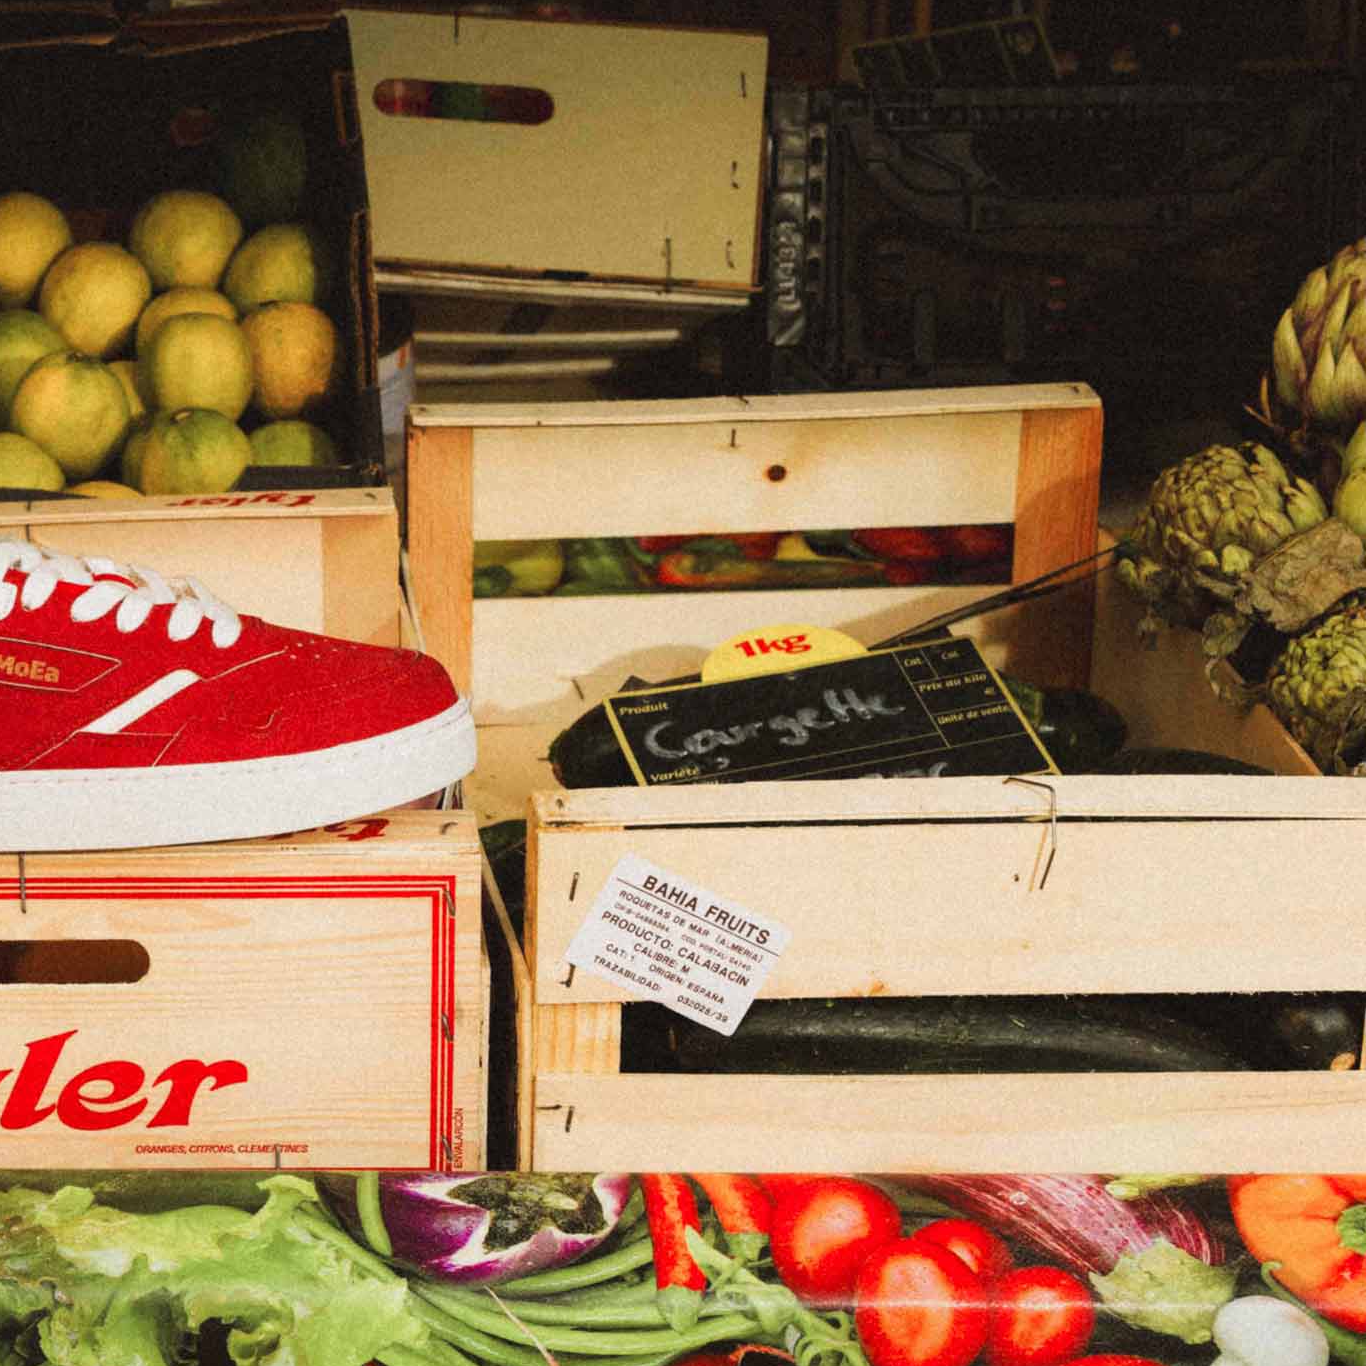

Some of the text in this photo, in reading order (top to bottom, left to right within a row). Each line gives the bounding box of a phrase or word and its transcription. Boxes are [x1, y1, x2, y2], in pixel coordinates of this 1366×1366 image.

[734, 633, 812, 658] 1kg
[918, 681, 942, 693] Prix
[964, 673, 987, 684] kilo
[617, 700, 670, 717] Produit
[619, 890, 671, 919] ROQUETAS
[673, 916, 686, 927] DE
[688, 922, 710, 937] MAR
[642, 874, 699, 912] BAHIA
[704, 904, 771, 946] FRUITS
[602, 910, 674, 952] PRODUCTO:
[677, 946, 751, 987] CALABACIN
[593, 955, 663, 992] TRAZABILIDAD:
[680, 965, 691, 974] M
[136, 1144, 187, 1155] ORANGES,
[188, 1144, 236, 1155] CITRONS,
